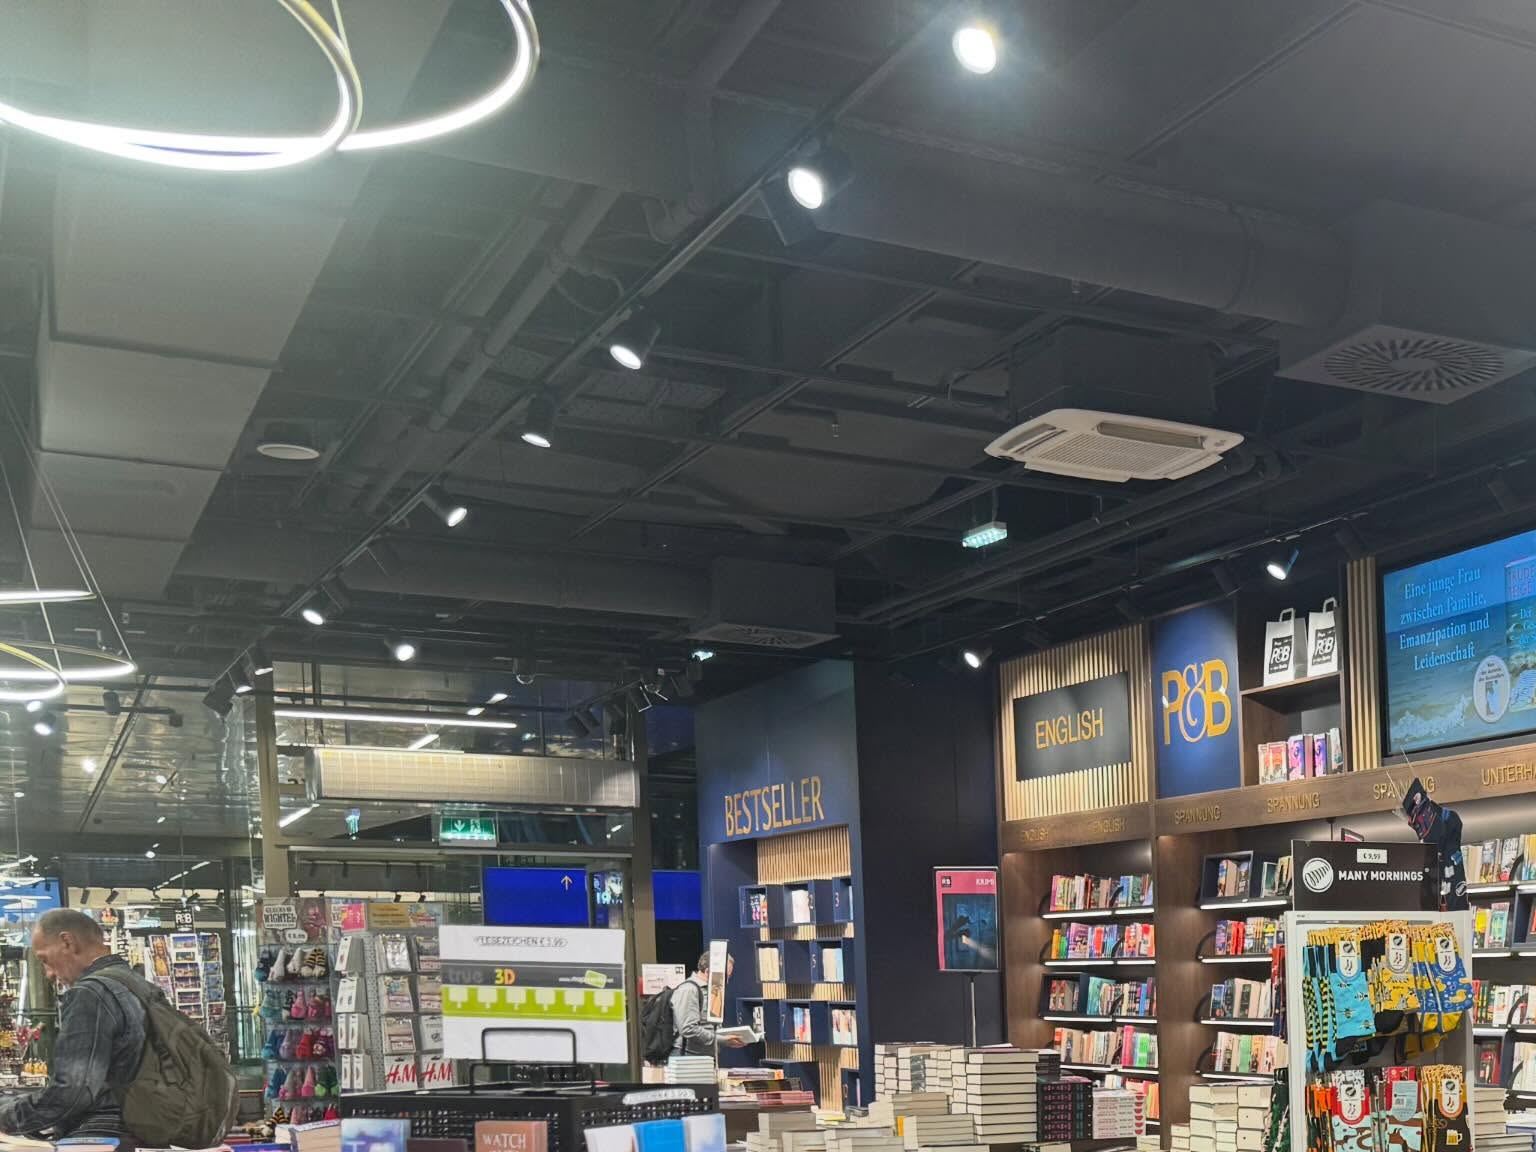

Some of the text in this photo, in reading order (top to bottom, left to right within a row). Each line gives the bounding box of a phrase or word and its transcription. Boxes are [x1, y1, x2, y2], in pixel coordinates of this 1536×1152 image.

[1404, 566, 1481, 600] Eine junge Frau
[1400, 602, 1444, 625] zwischen
[1400, 612, 1490, 650] Emanzipation und
[1414, 642, 1476, 672] Leidenschaft
[1162, 659, 1232, 747] P&B
[1035, 708, 1104, 750] ENGLISH
[725, 776, 825, 836] BESTSELLER
[1174, 805, 1221, 825] SPANNUNG
[1266, 793, 1320, 815] SPANNUNG
[1094, 816, 1126, 834] ENGLISH
[1338, 869, 1424, 882] MANY MORNINGS
[494, 968, 516, 986] 3D
[482, 1133, 526, 1148] WATCH
